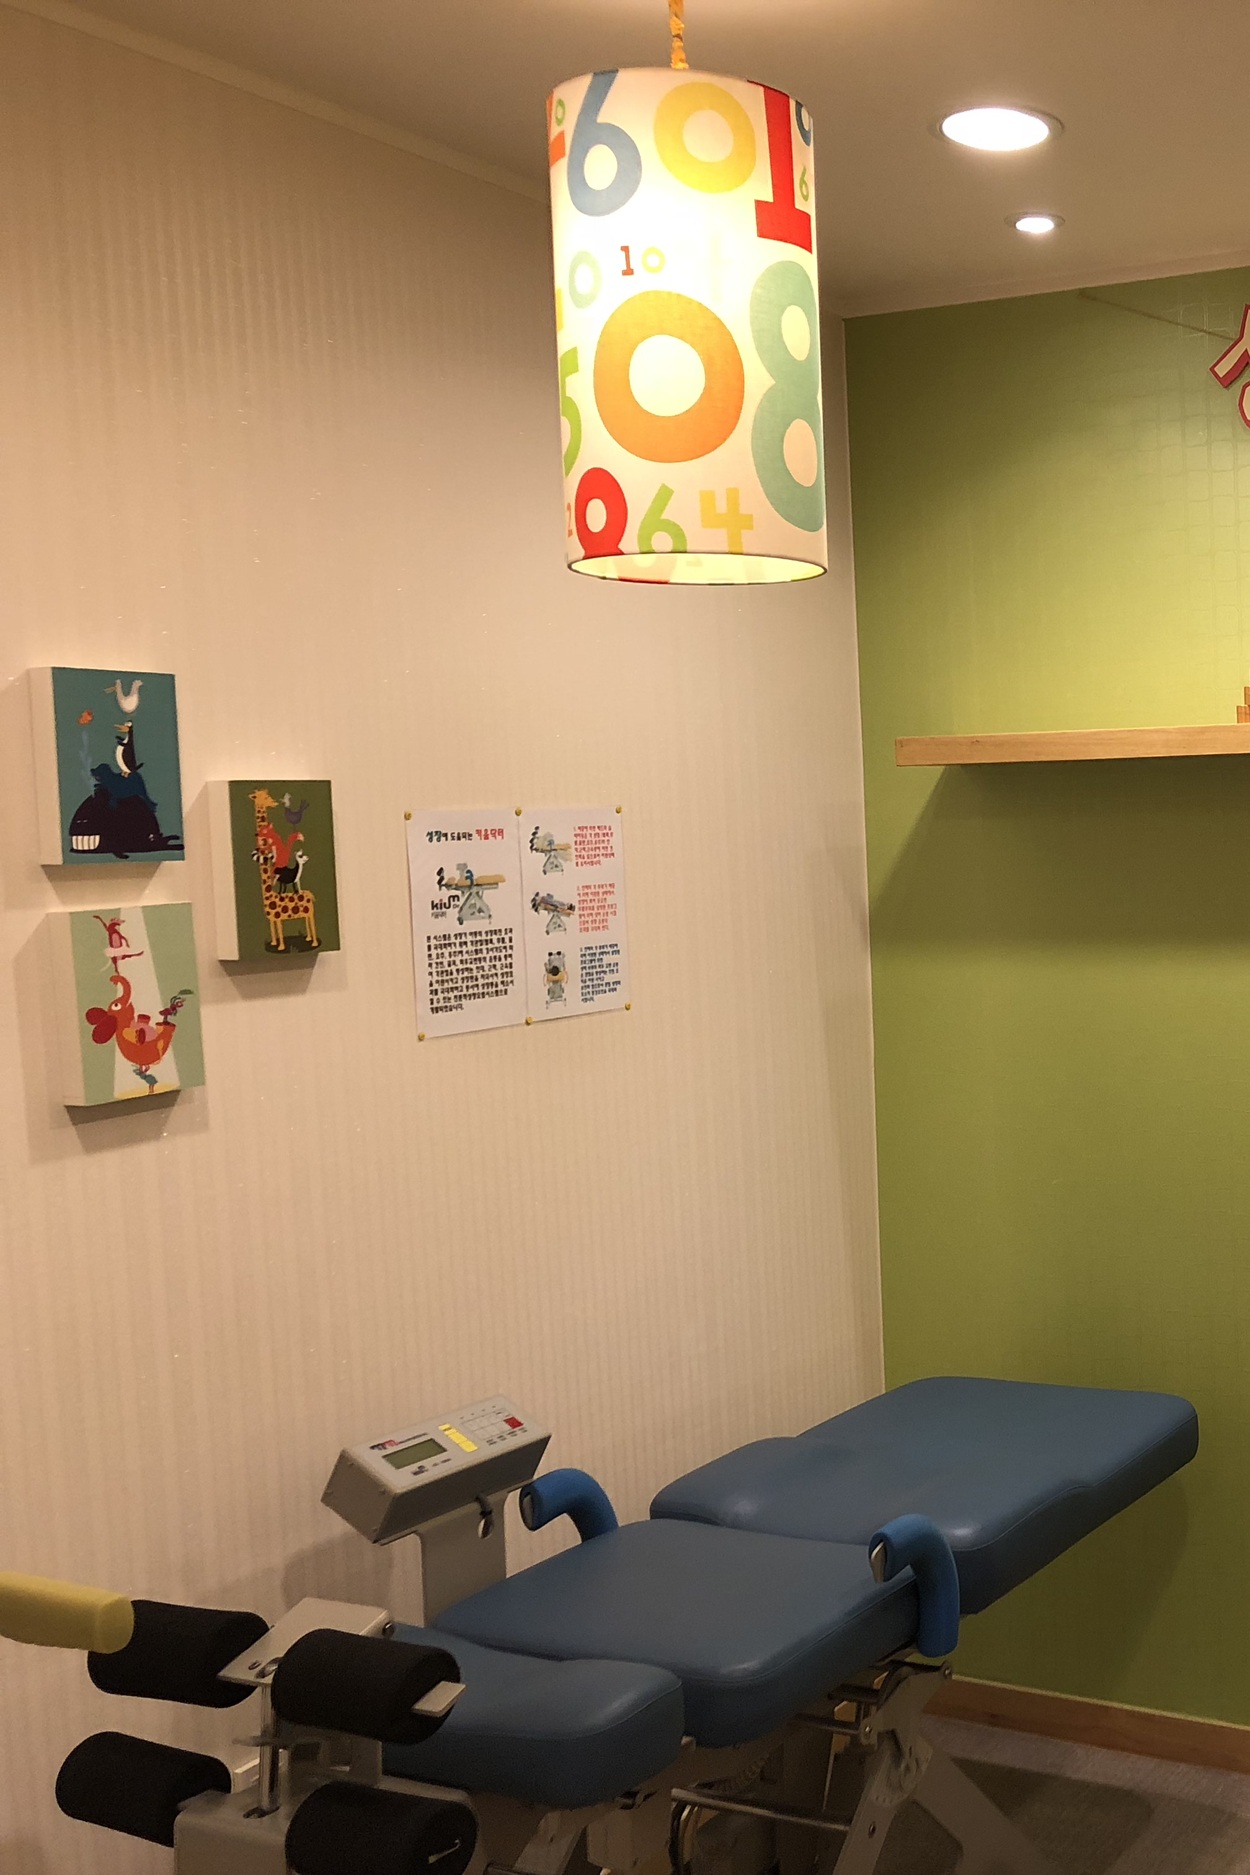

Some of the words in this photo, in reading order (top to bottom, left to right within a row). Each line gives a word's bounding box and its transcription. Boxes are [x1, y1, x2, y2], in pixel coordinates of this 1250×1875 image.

[426, 830, 448, 843] 성장에
[450, 831, 473, 842] 도움되는
[475, 828, 504, 841] 키움닥터
